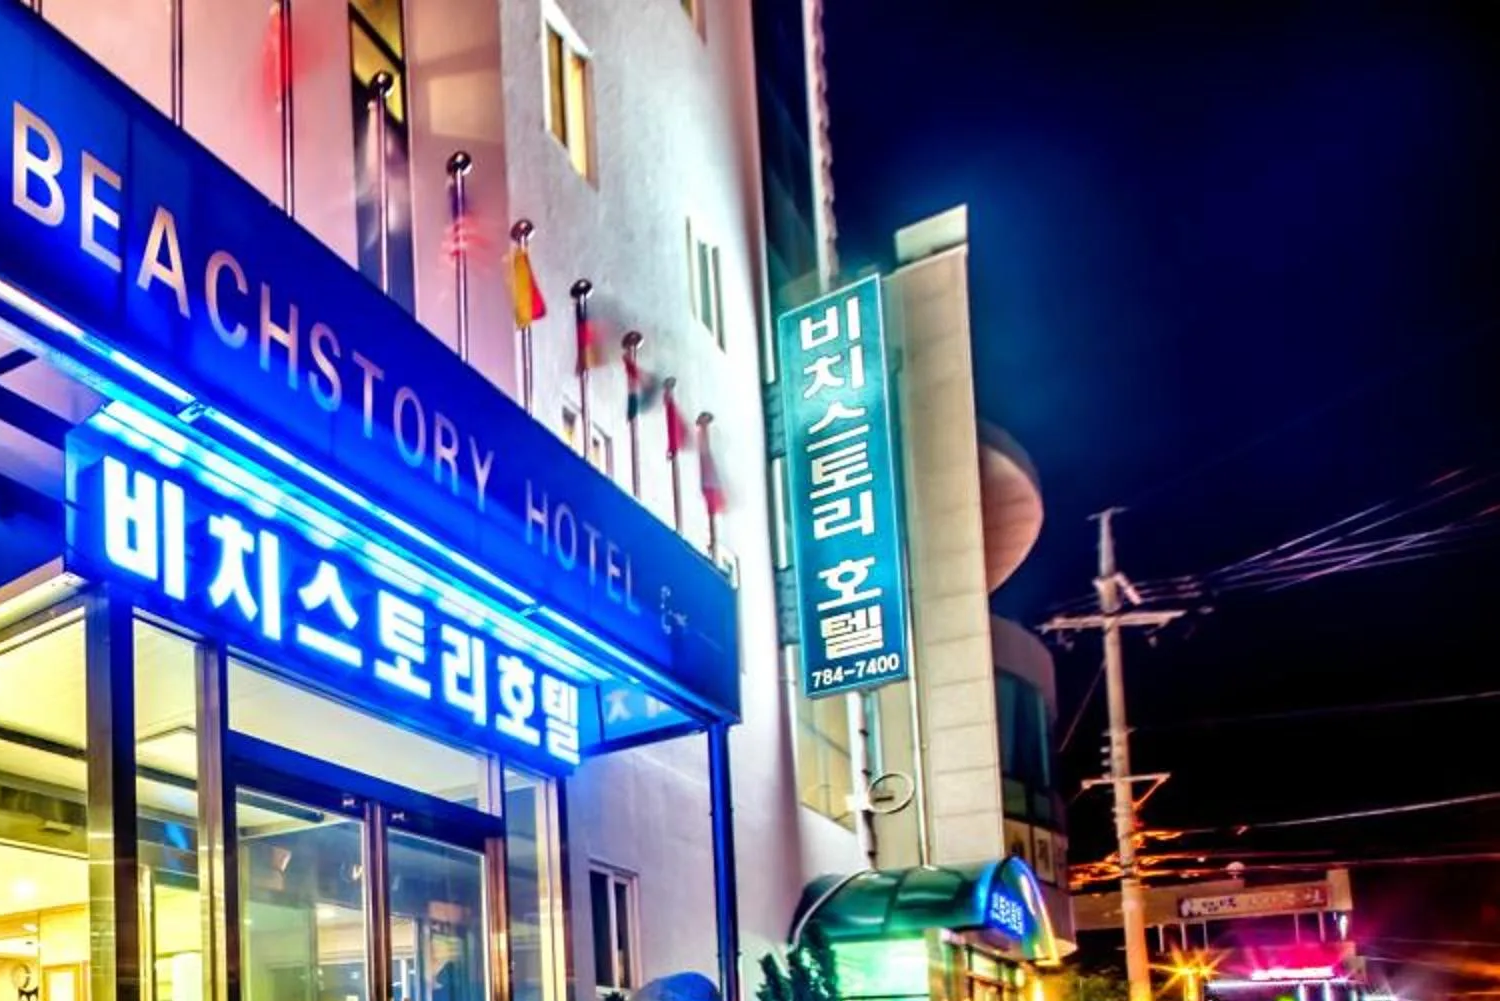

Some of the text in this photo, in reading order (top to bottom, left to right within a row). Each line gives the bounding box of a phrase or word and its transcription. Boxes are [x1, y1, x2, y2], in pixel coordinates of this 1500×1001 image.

[12, 101, 642, 617] BEACHSTORY HOTEL
[800, 296, 884, 661] 비치스토리 호텔
[102, 454, 581, 767] 비치스토리호텔
[811, 652, 901, 689] 784-7400
